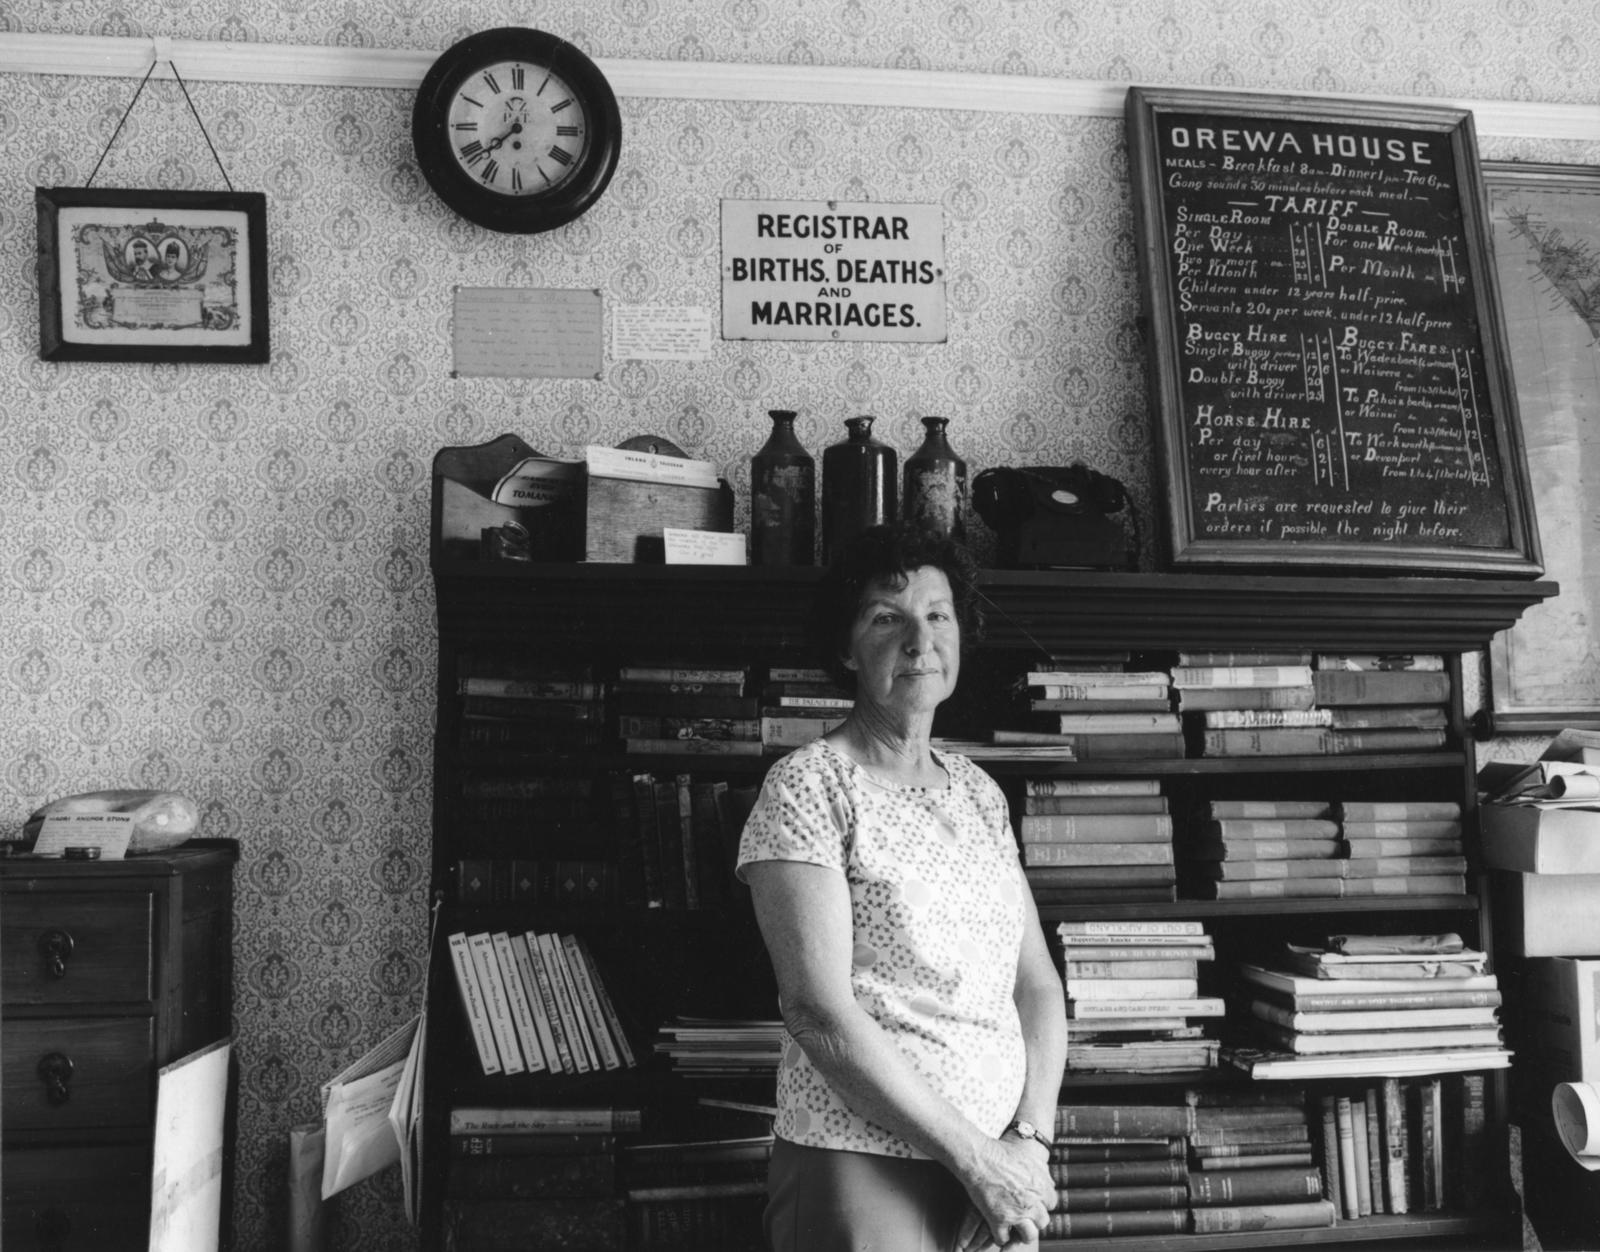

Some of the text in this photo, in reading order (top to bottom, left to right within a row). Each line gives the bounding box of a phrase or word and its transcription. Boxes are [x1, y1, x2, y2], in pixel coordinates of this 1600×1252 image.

[1171, 127, 1432, 165] OREWA HOUSE
[1222, 156, 1295, 173] Breakfast
[1330, 163, 1377, 180] Dinner
[1404, 169, 1426, 185] Tea
[1169, 172, 1202, 191] Gong
[1207, 180, 1247, 190] sounds
[1250, 181, 1266, 191] 30
[1268, 181, 1311, 193] minutes
[1313, 182, 1346, 195] before
[1349, 184, 1374, 197] each
[1264, 195, 1358, 217] TARIFF
[757, 214, 909, 240] REGISTRAR
[1174, 223, 1243, 244] Per Day
[824, 243, 843, 254] OF
[1173, 237, 1253, 254] One Week
[1324, 230, 1414, 253] For one Week
[1174, 250, 1258, 267] Two or more
[1328, 255, 1415, 279] Per Month
[837, 258, 934, 285] DEATHS
[1177, 263, 1201, 276] Per
[1207, 264, 1257, 278] Month
[817, 287, 851, 298] AND
[1178, 277, 1237, 294] Children
[1244, 285, 1279, 296] under
[1287, 287, 1301, 297] 12
[1303, 290, 1335, 301] years
[751, 301, 921, 327] MARRIAGES.
[1180, 292, 1241, 314] Servants
[1273, 307, 1298, 321] per
[1341, 309, 1377, 322] under
[1379, 312, 1393, 325] 12
[1185, 339, 1229, 361] Single
[1232, 342, 1271, 360] Buggy
[1336, 346, 1352, 360] To
[1188, 367, 1321, 389] Double Buggy 20
[1228, 359, 1330, 377] with driver 17 6
[1460, 368, 1469, 378] 2
[1230, 387, 1260, 399] with
[1265, 388, 1305, 400] driver
[1343, 388, 1359, 402] To
[1365, 388, 1397, 405] Puhoi
[1461, 389, 1469, 400] 7
[1465, 408, 1472, 419] 3
[1393, 422, 1415, 433] from
[1198, 427, 1324, 451] Per day 6
[1345, 432, 1362, 446] To
[1367, 433, 1429, 449] Warkworth
[1214, 447, 1327, 464] or first hour 2
[1364, 447, 1421, 467] Devonport
[1199, 462, 1326, 479] every hour after 1
[1383, 466, 1407, 478] from
[1204, 492, 1468, 519] Parties are requested to give their
[1206, 520, 1251, 533] orders
[1260, 520, 1271, 533] if
[1280, 521, 1327, 539] possible
[1337, 520, 1360, 535] the
[1373, 521, 1409, 540] night
